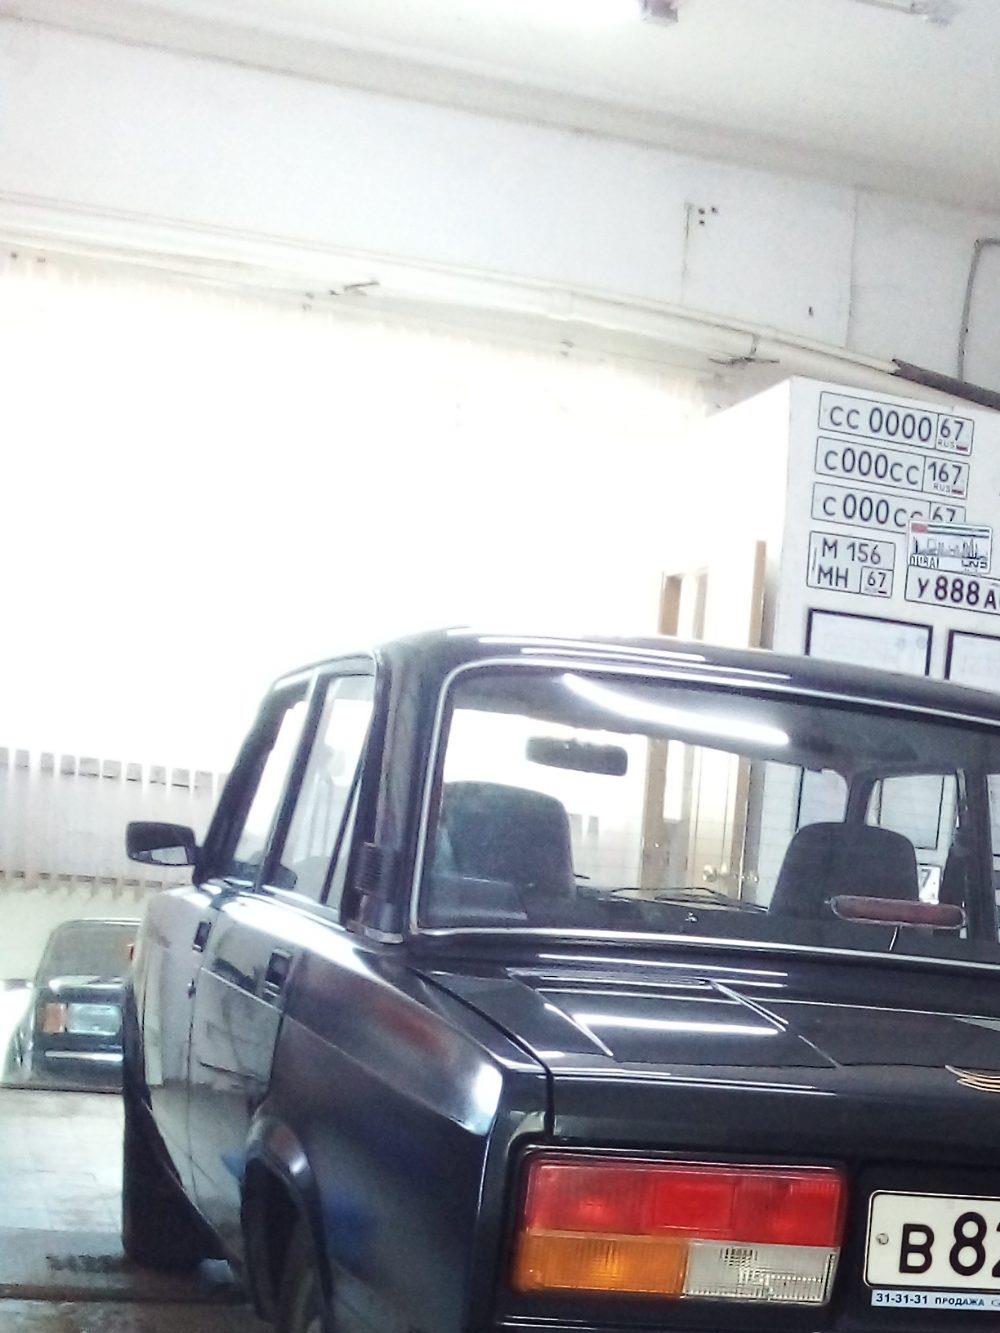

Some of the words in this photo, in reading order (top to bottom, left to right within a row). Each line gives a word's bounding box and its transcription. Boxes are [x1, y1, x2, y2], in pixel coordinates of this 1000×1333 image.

[940, 418, 964, 441] 67
[928, 461, 962, 485] 167
[847, 542, 881, 565] 156
[867, 571, 886, 588] 67
[875, 1292, 928, 1305] 31-31-31
